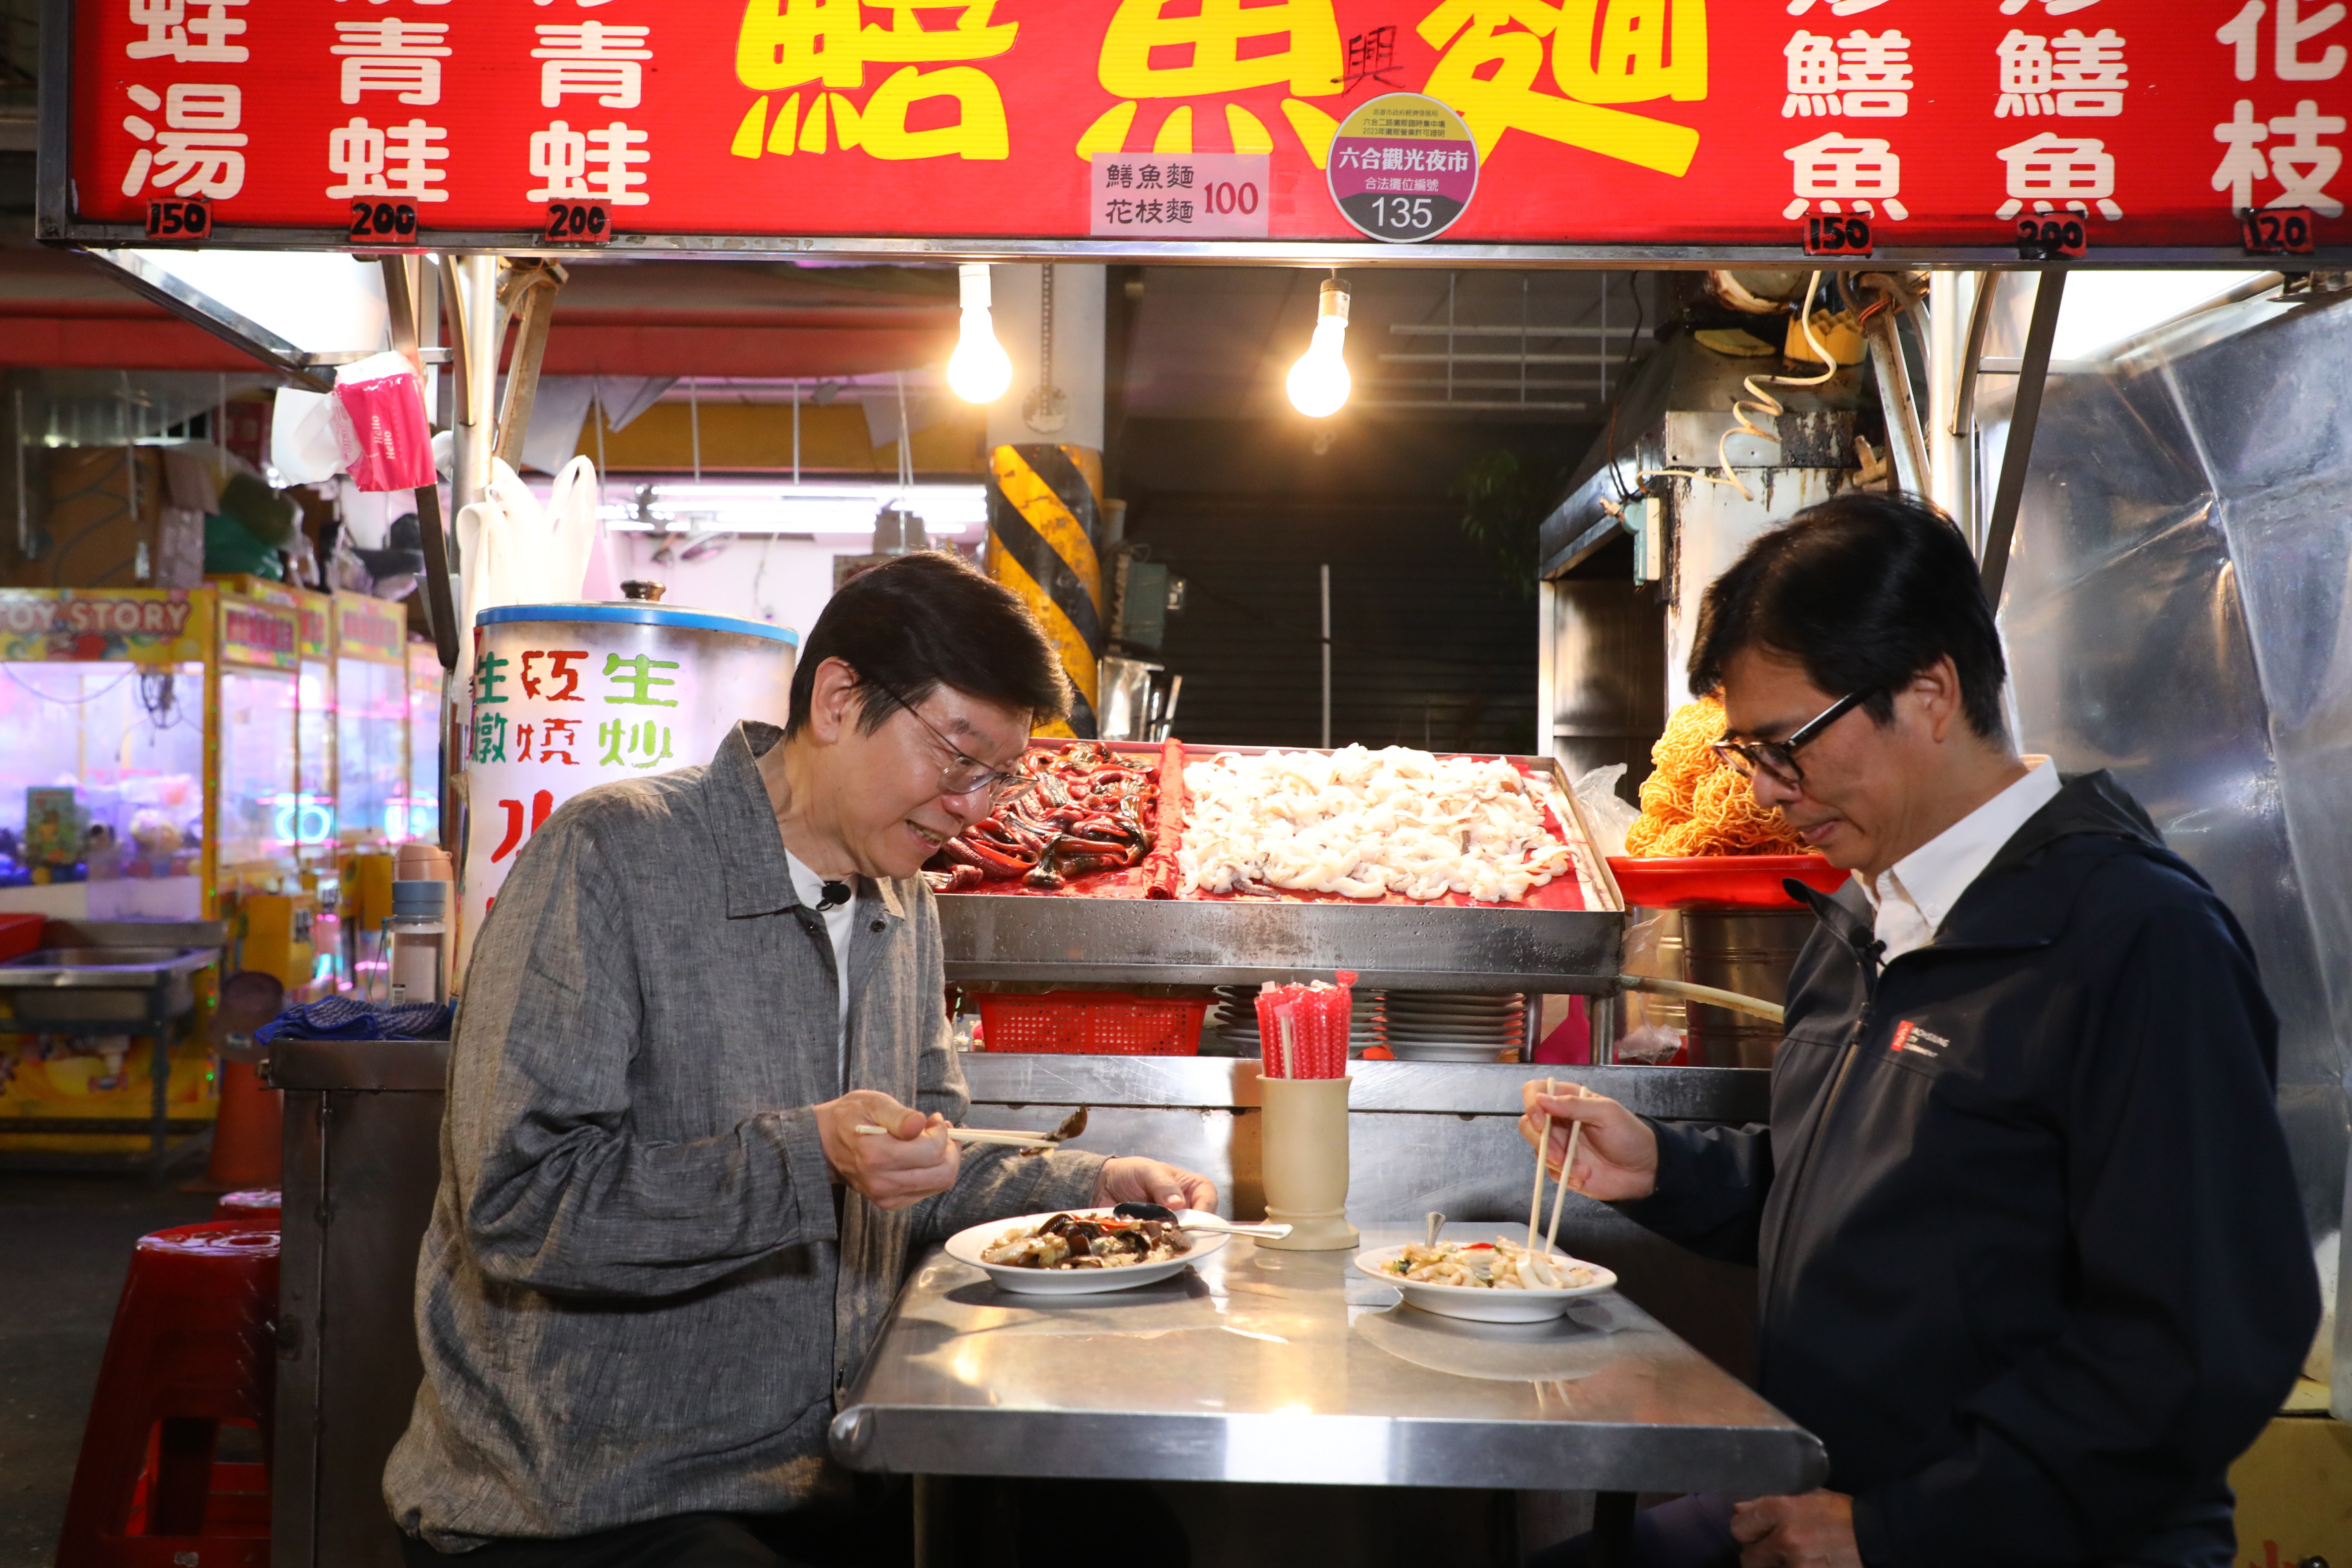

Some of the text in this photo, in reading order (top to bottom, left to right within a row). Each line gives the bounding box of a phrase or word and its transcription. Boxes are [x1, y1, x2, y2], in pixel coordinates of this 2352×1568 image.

[326, 0, 452, 202] 青蛙
[526, 0, 653, 205] 青蛙
[1781, 0, 1913, 220] 鱔魚
[1994, 0, 2129, 220] 鱔魚
[1339, 147, 1468, 172] 六合觀光夜市
[1106, 163, 1194, 189] 鱔魚麵
[1365, 177, 1439, 191] 合法攤位編號
[1106, 198, 1194, 224] 花枝麵
[1205, 182, 1258, 214] 100
[1372, 197, 1432, 228] 135
[150, 202, 206, 234] 150
[351, 202, 416, 235] 200
[548, 204, 606, 237] 200
[1809, 217, 1869, 249] 150
[2246, 216, 2307, 248] 120
[2018, 220, 2084, 250] 200
[371, 415, 383, 444] Hello
[384, 431, 396, 459] Hello
[0, 602, 57, 631] OY
[71, 602, 190, 632] STORY
[599, 653, 680, 768] 生炒
